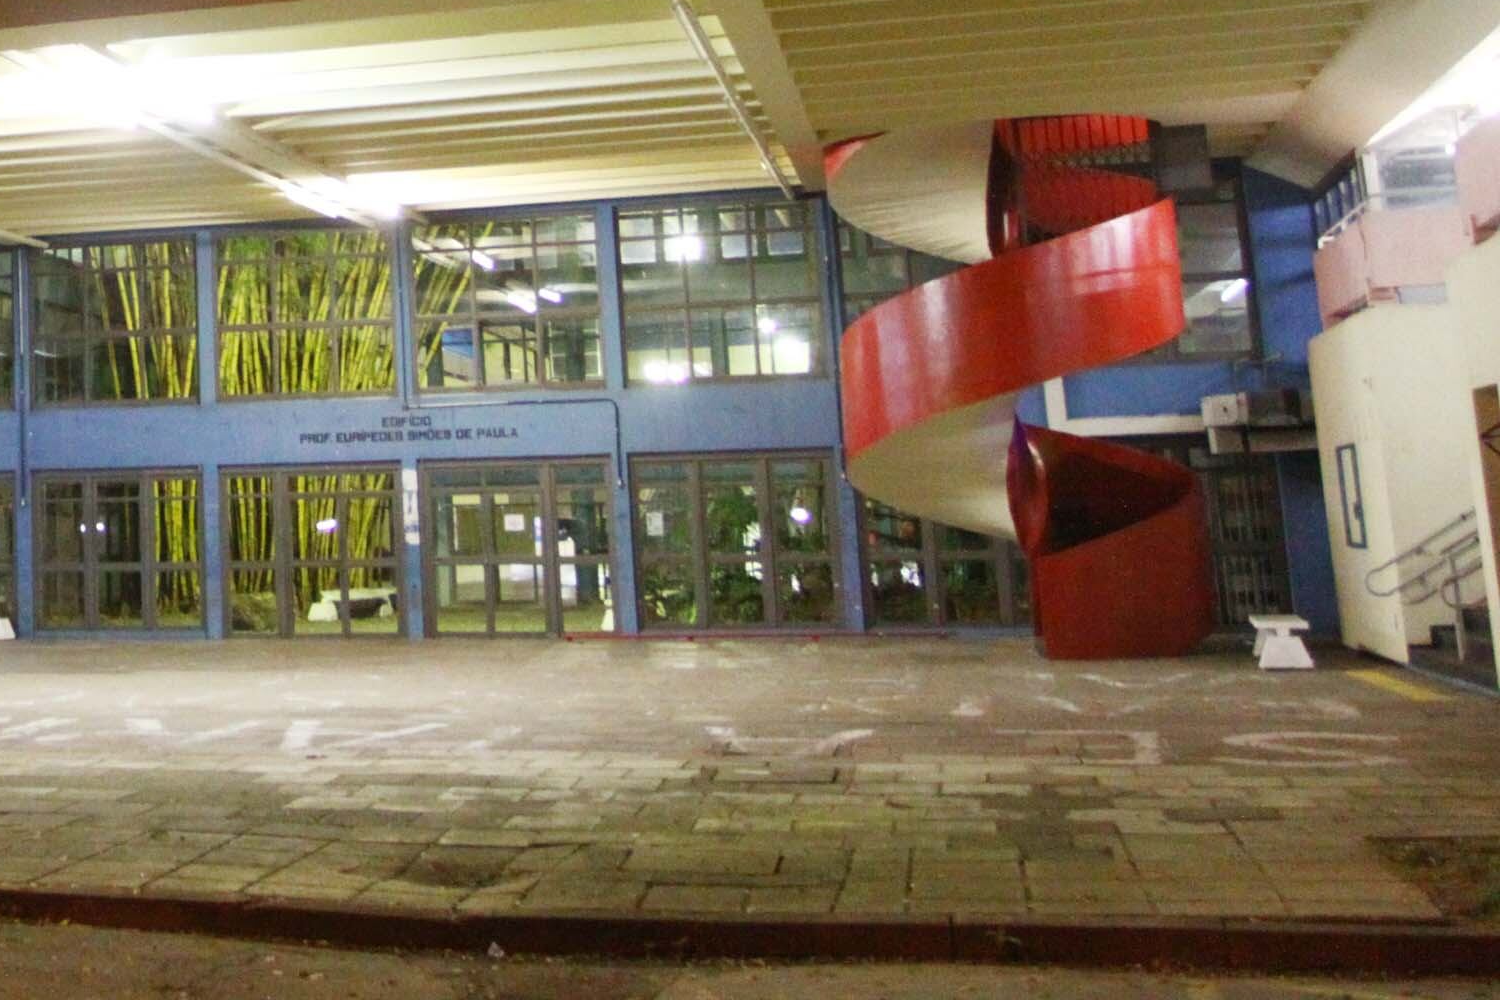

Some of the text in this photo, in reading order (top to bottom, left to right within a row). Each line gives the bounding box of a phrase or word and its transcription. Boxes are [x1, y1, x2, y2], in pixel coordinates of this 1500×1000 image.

[380, 414, 432, 428] EDIFÍCIO
[455, 428, 472, 440] DE
[476, 427, 519, 439] PAULA
